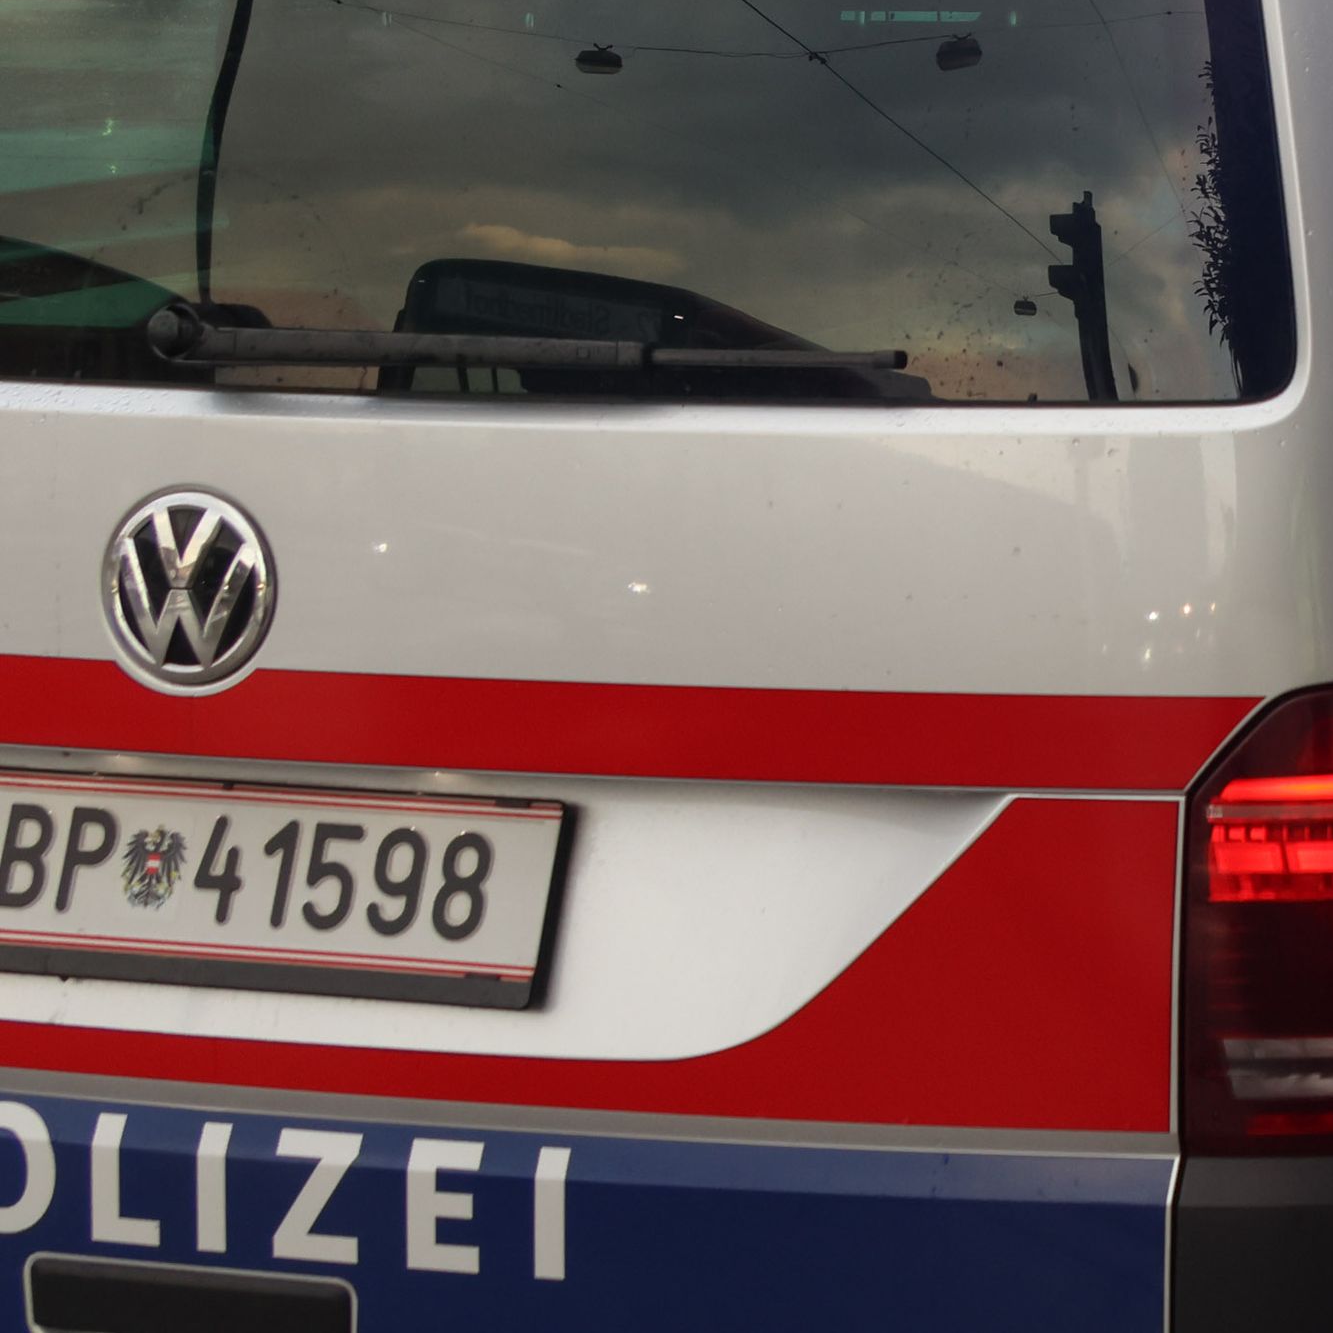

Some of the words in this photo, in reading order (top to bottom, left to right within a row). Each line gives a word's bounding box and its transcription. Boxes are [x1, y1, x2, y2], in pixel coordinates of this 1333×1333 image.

[0, 803, 118, 914] BP
[194, 813, 494, 941] 41598
[0, 1101, 571, 1281] OLIZEI
